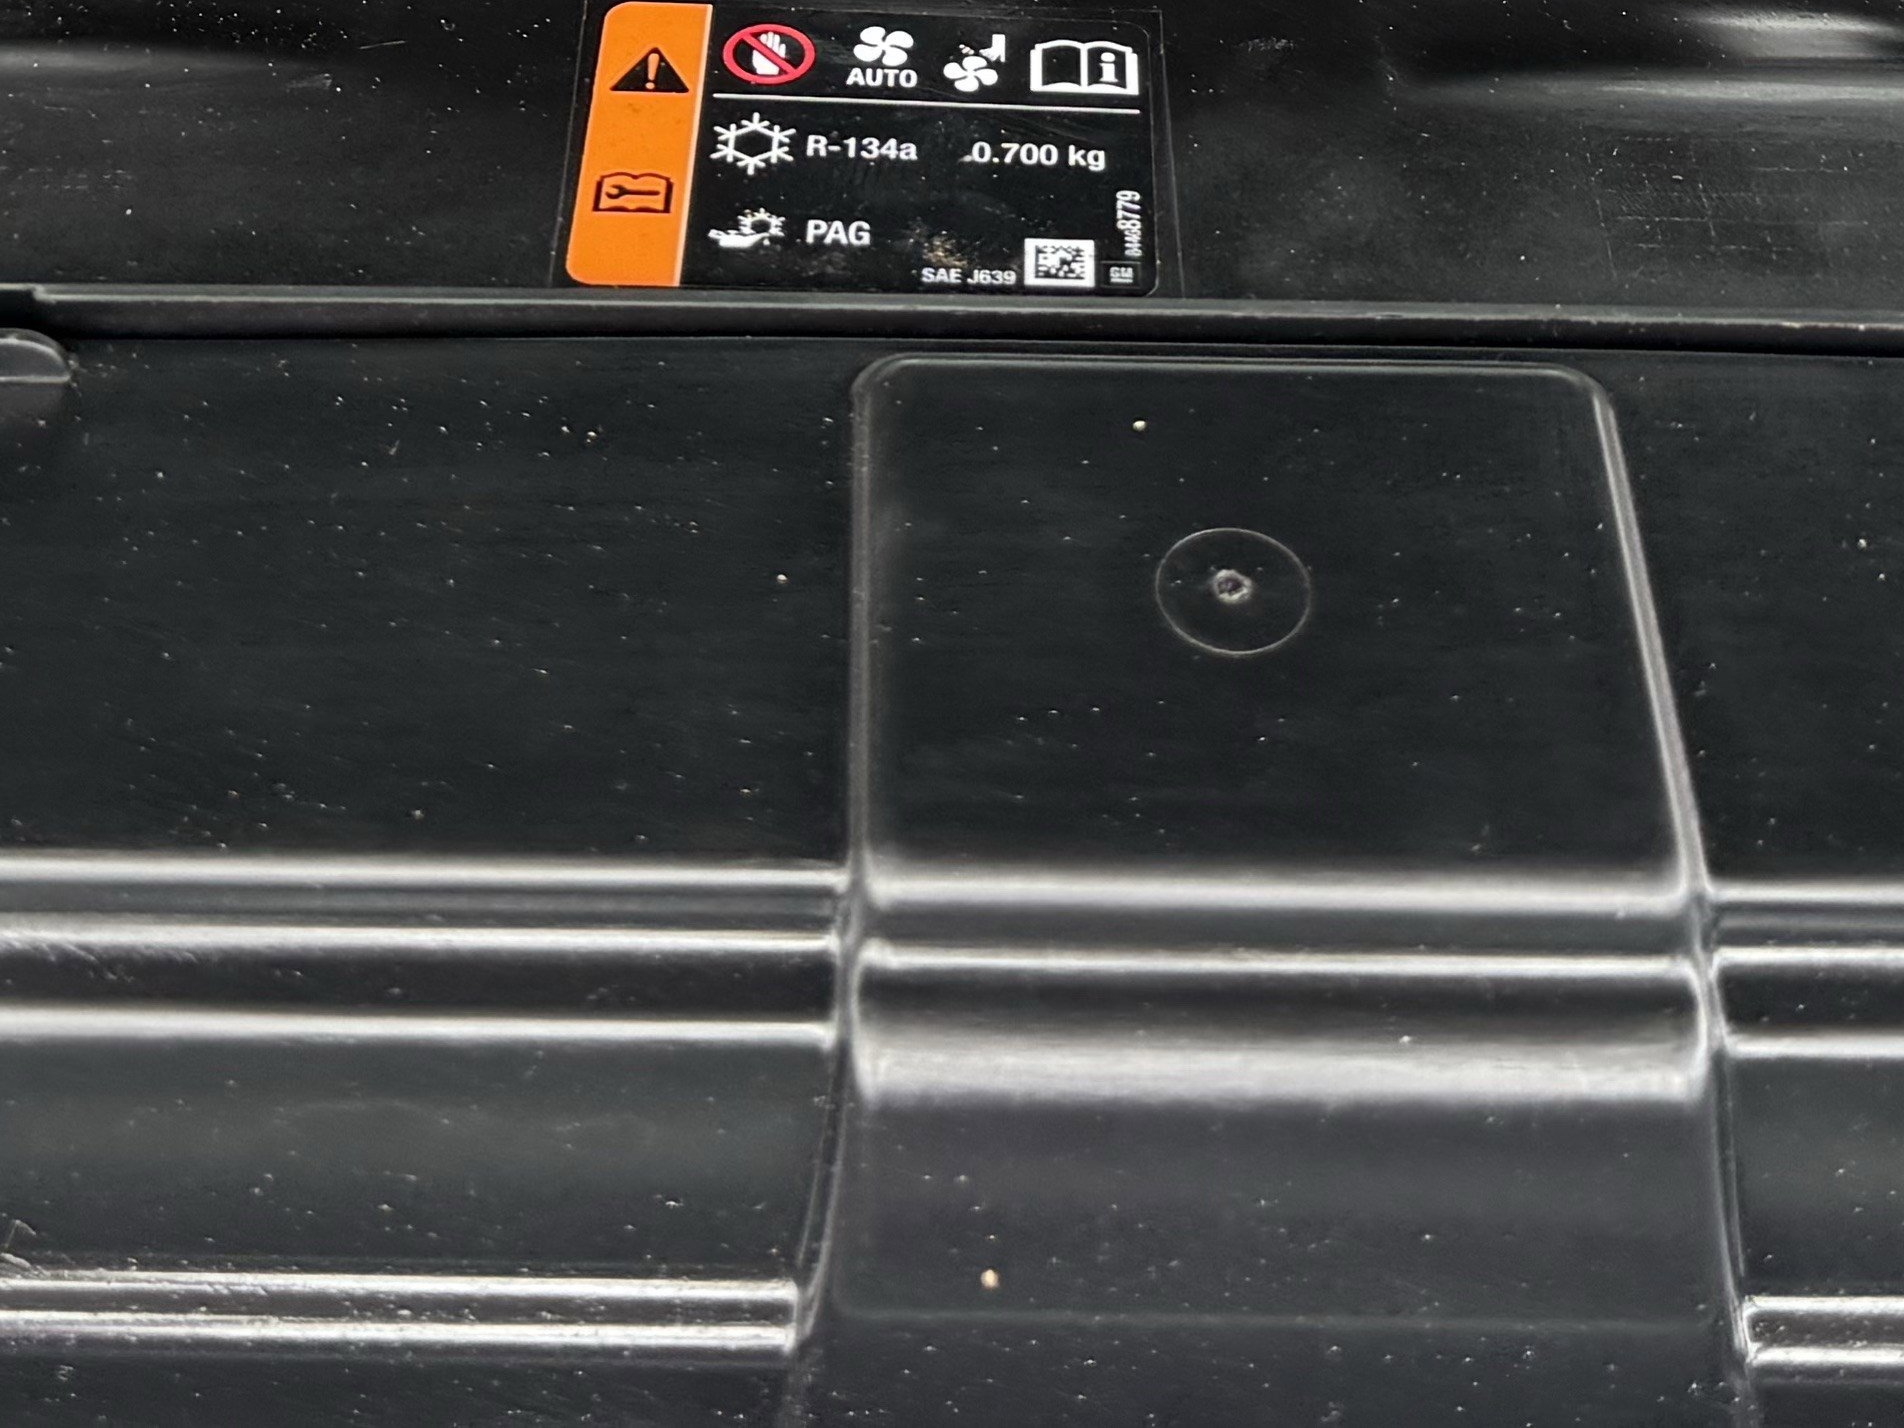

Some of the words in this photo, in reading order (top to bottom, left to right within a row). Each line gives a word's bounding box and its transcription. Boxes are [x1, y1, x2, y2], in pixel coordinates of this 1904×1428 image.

[846, 67, 918, 88] AUTO
[806, 134, 918, 161] R-134a
[971, 141, 1059, 165] 0.700
[1068, 144, 1106, 171] kg
[805, 219, 871, 246] PAG
[921, 267, 962, 284] SAE
[966, 269, 1016, 285] J639
[1109, 266, 1133, 283] GM
